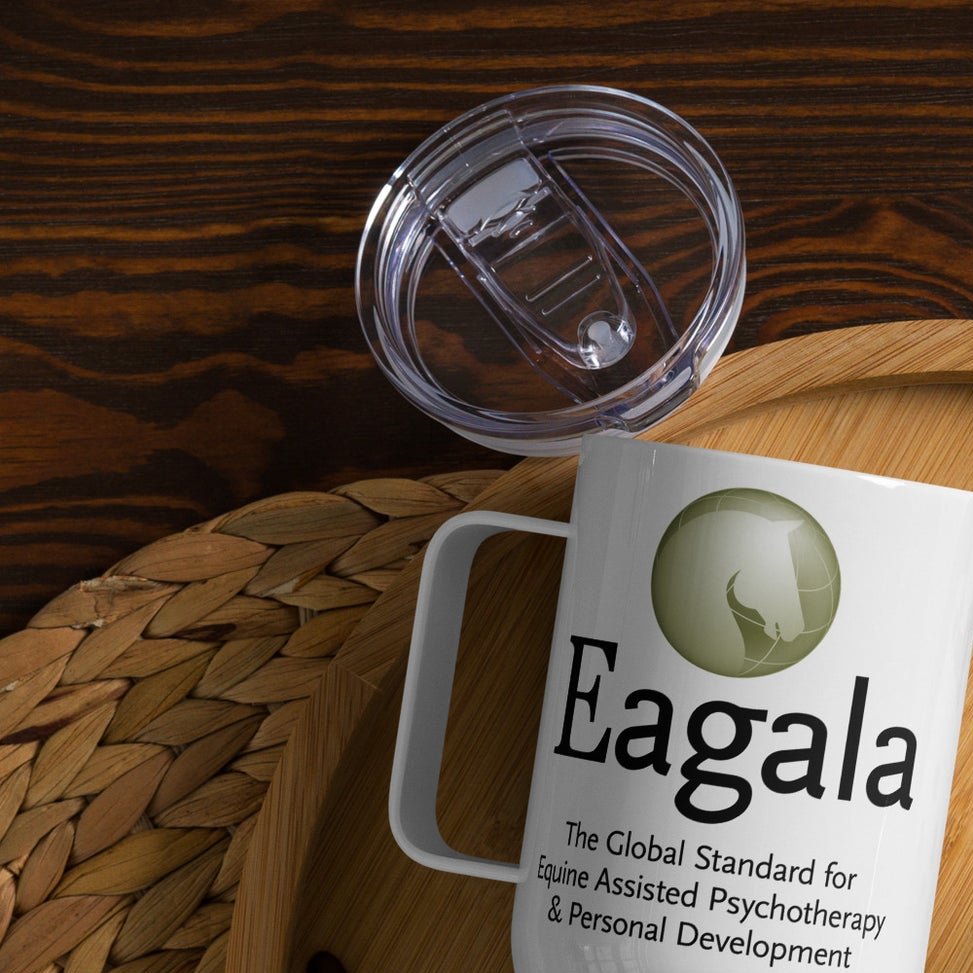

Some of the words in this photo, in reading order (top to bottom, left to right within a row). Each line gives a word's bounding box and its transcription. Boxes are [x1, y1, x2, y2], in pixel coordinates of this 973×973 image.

[553, 634, 917, 825] Eagala
[565, 820, 599, 852] The
[606, 830, 686, 867] Global
[694, 844, 816, 886] Standard
[824, 861, 858, 890] for
[537, 854, 590, 890] Equine
[593, 867, 699, 908] Assisted
[709, 886, 886, 940] Psychotherapy
[547, 894, 563, 924] &
[568, 901, 667, 943] Personal
[676, 921, 852, 969] Development
